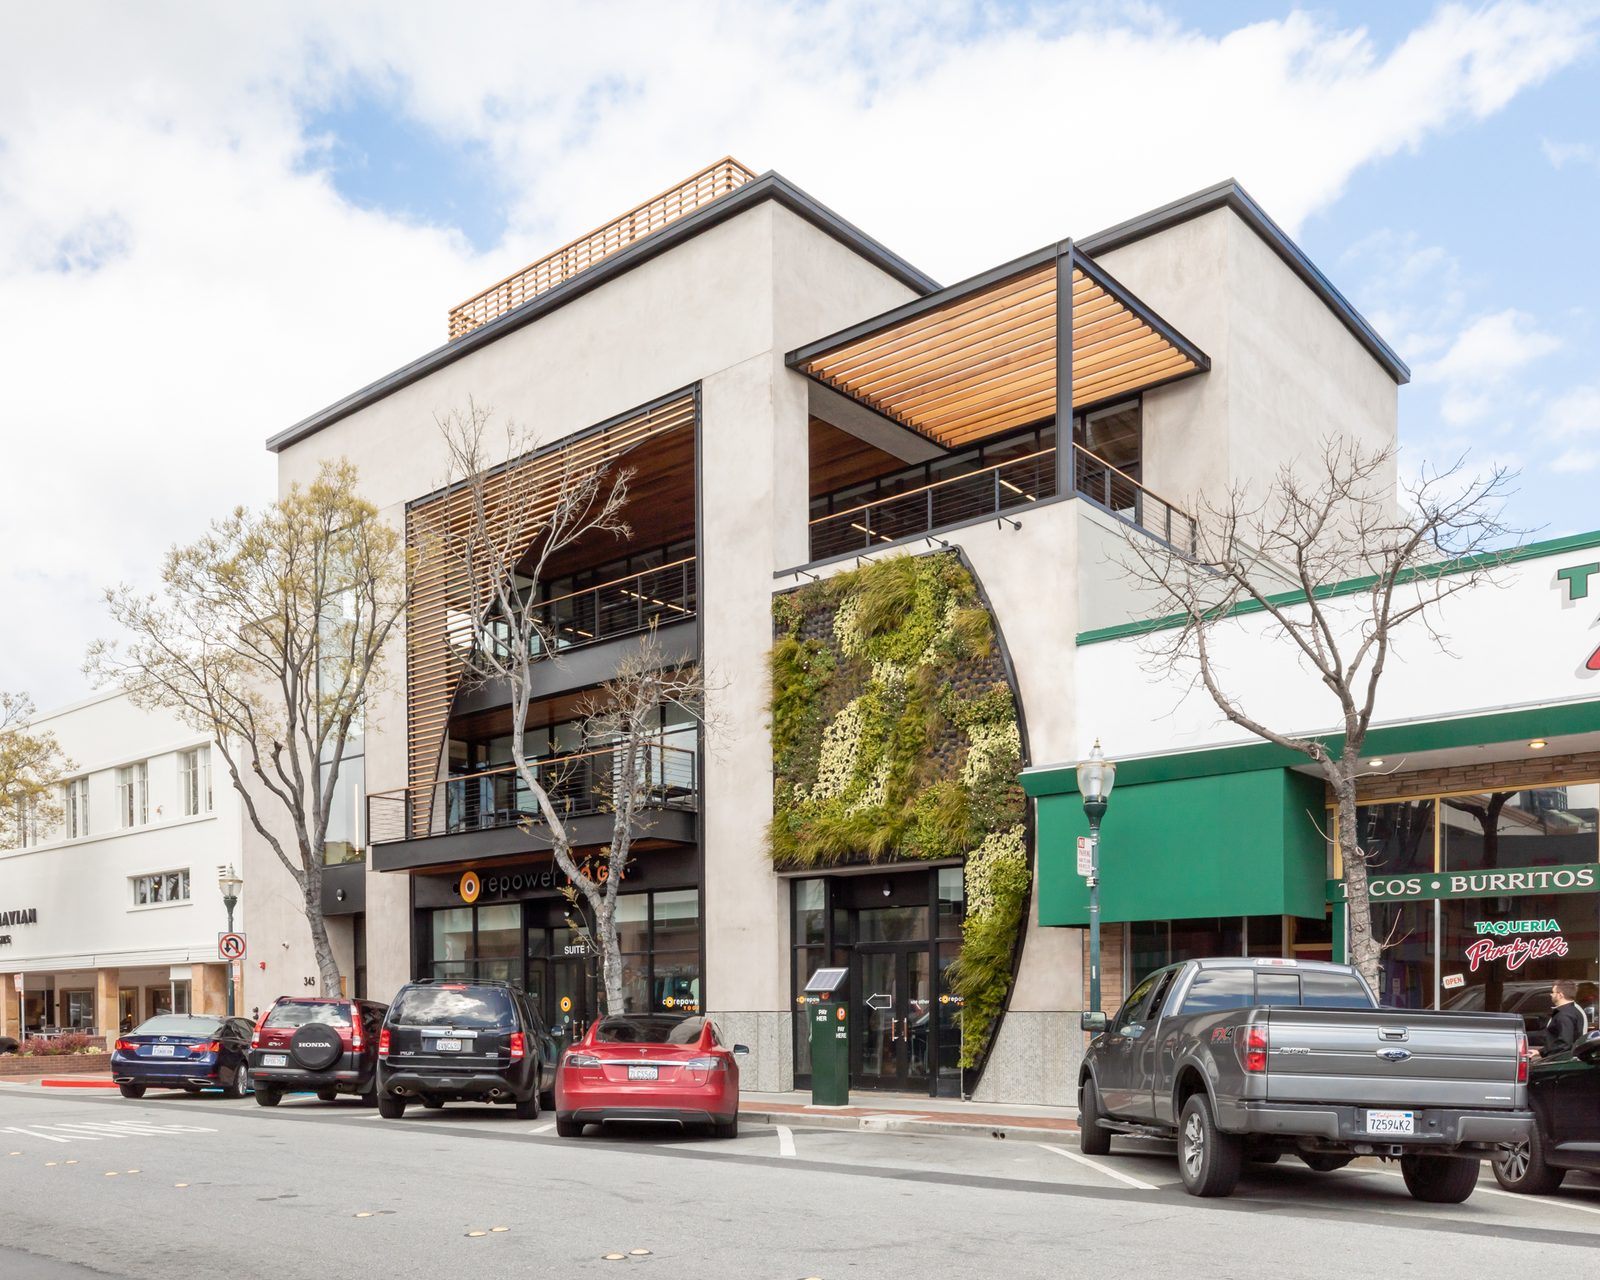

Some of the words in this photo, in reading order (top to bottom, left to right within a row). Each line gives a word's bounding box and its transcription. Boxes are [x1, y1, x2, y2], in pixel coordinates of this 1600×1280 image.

[1339, 879, 1421, 898] TCOS
[1450, 869, 1594, 893] BURRITOS
[0, 908, 37, 926] AVIAN
[1474, 919, 1561, 936] TAQUERIA
[564, 945, 585, 955] SUITE
[1465, 938, 1529, 972] Pancho
[1506, 936, 1568, 971] Villa
[303, 976, 316, 987] 345
[1445, 976, 1463, 985] OPEN
[1370, 1119, 1411, 1131] 72594K2
